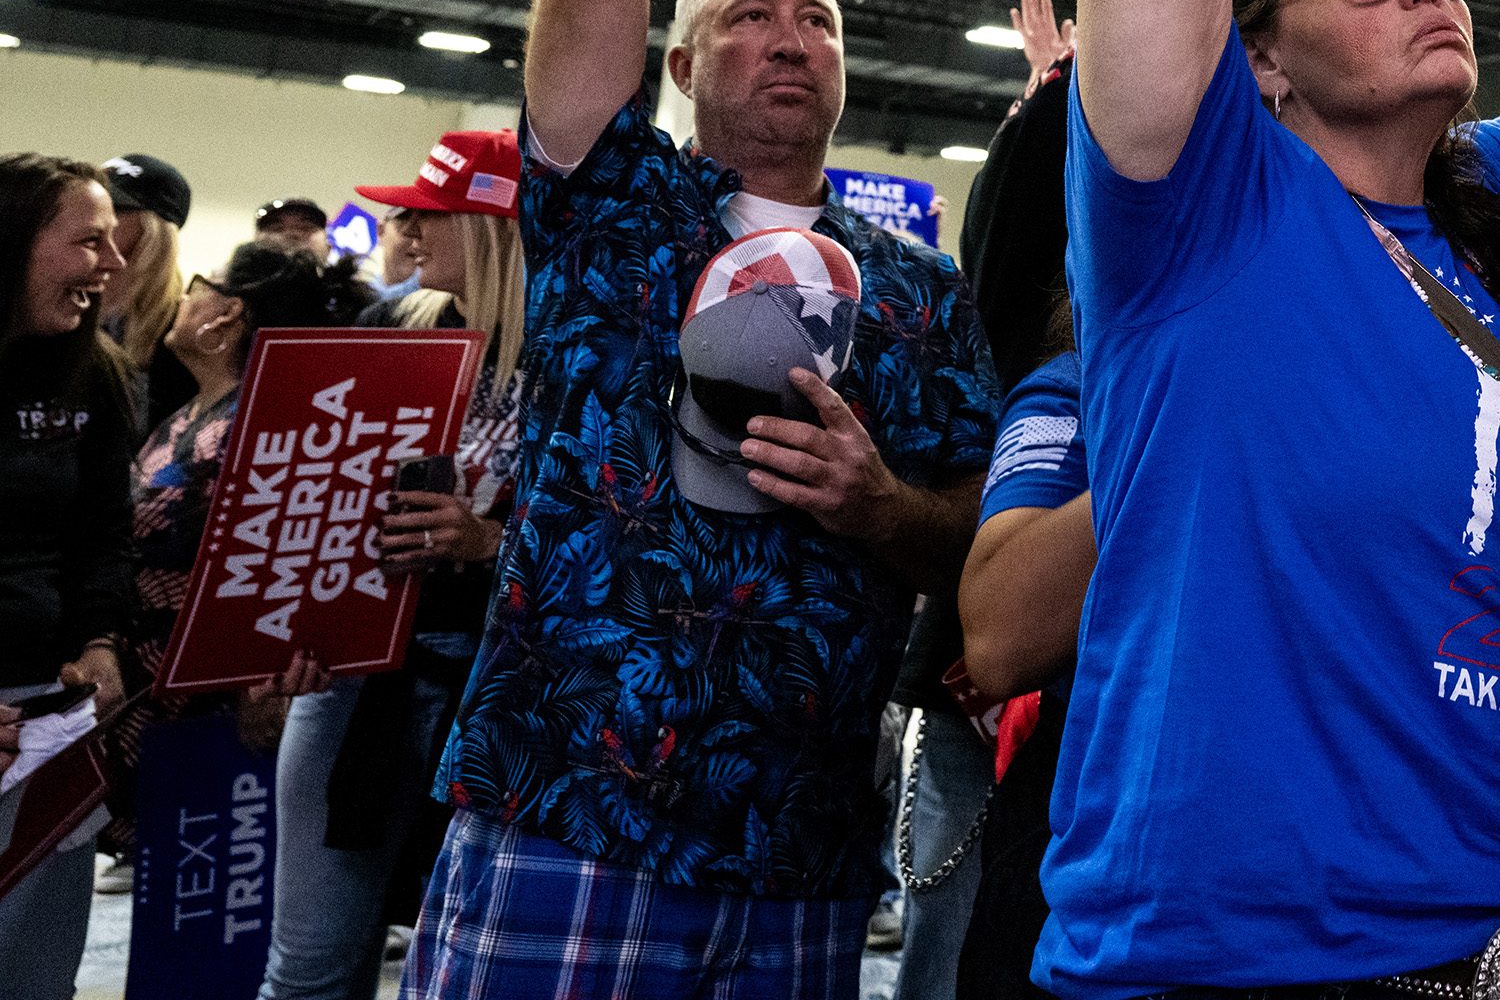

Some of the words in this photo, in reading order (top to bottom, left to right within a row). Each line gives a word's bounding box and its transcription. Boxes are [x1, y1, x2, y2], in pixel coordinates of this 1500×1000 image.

[843, 195, 922, 221] MERICA
[845, 178, 906, 202] MAKE
[215, 430, 294, 599] MAKE
[254, 376, 356, 642] AMERICA
[309, 411, 388, 602] GREAT
[174, 806, 219, 932] TEXT
[223, 772, 268, 945] TRUMP
